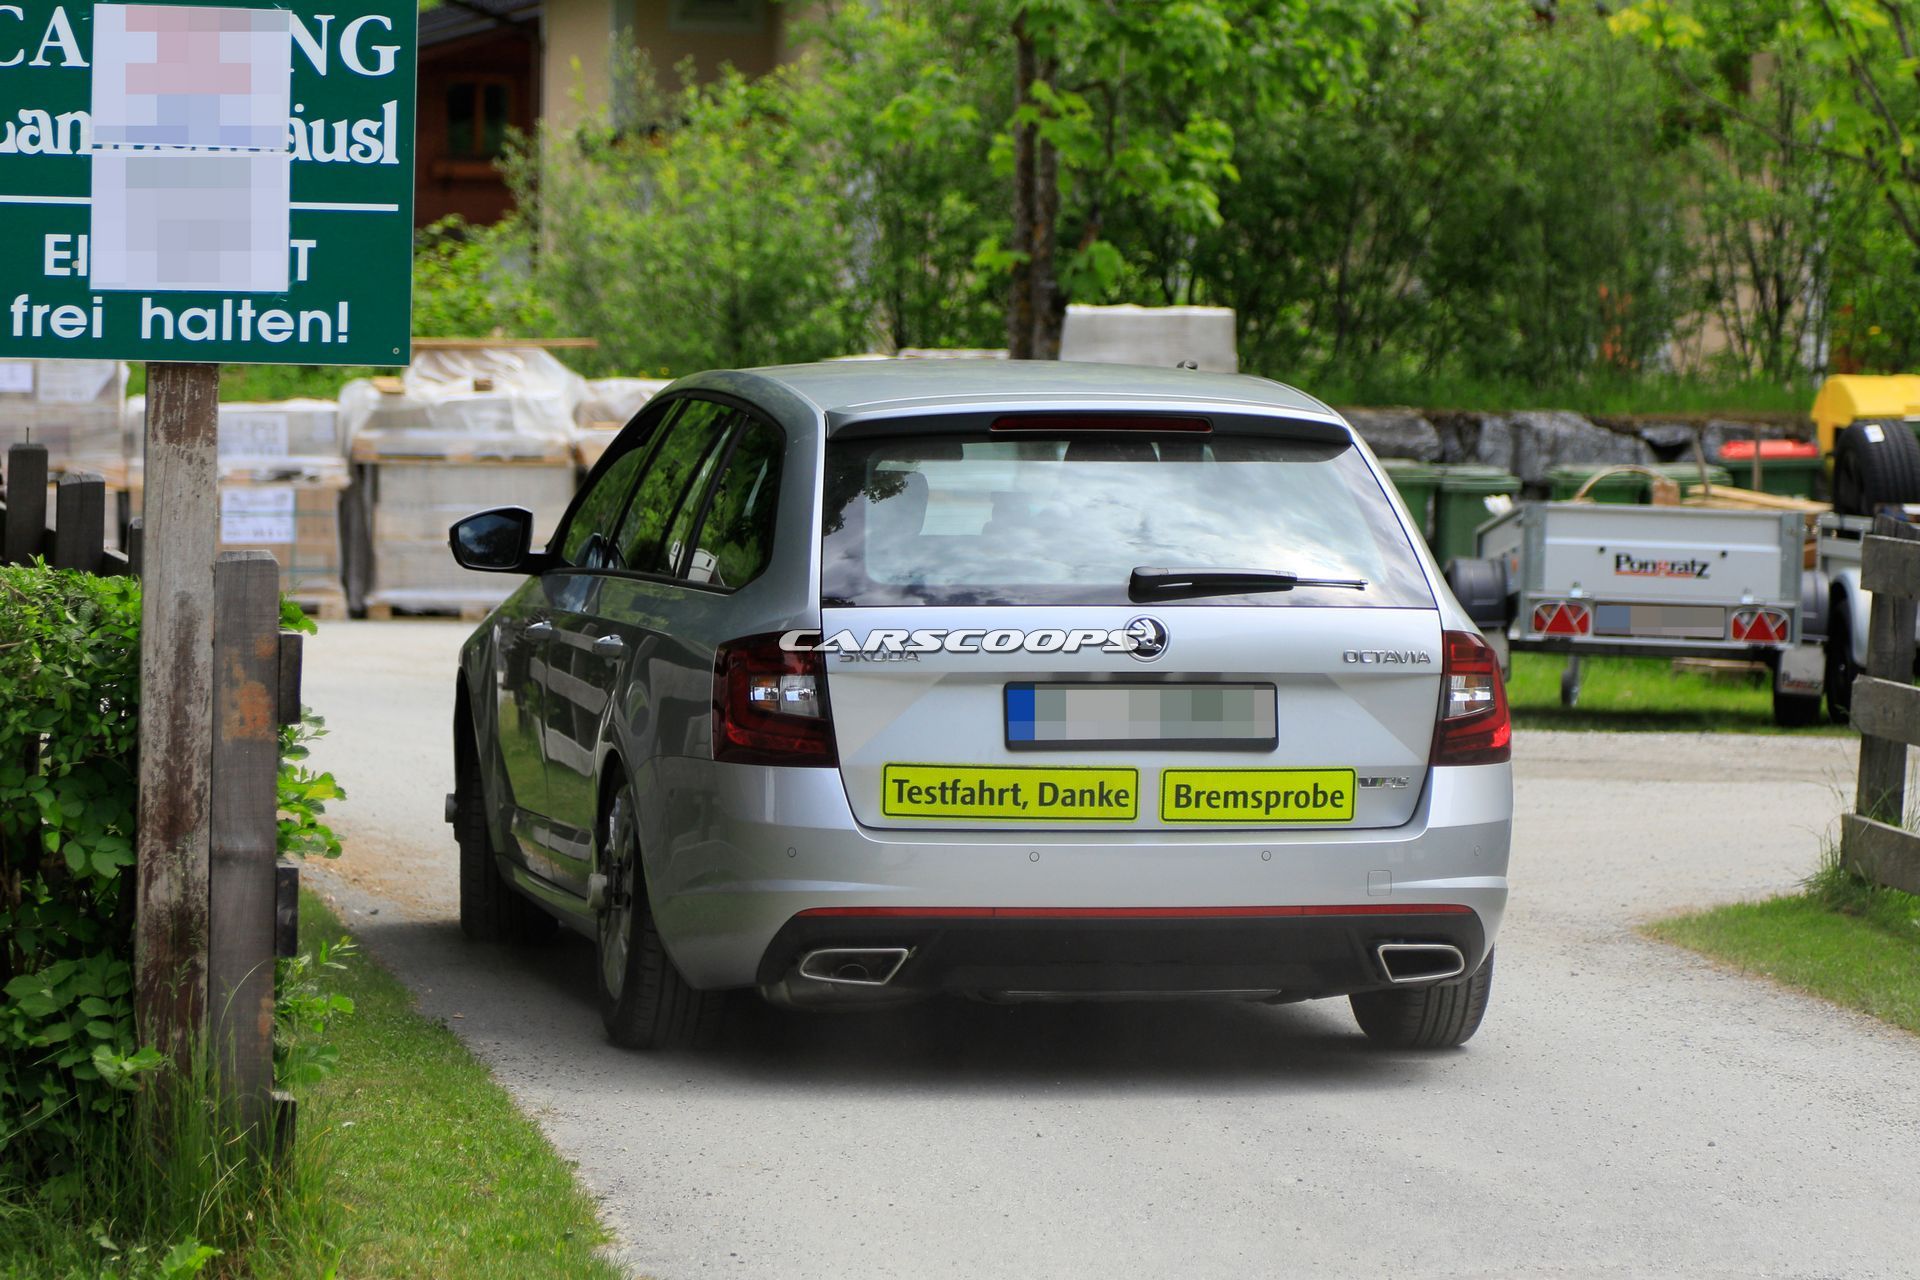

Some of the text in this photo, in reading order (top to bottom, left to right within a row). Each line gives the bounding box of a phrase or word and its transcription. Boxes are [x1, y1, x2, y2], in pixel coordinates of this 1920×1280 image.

[11, 294, 349, 343] frei halten!
[1342, 650, 1431, 664] OCTAVIA
[892, 779, 1130, 810] Testfahrt, Danke
[1174, 783, 1345, 815] Bremsprobe
